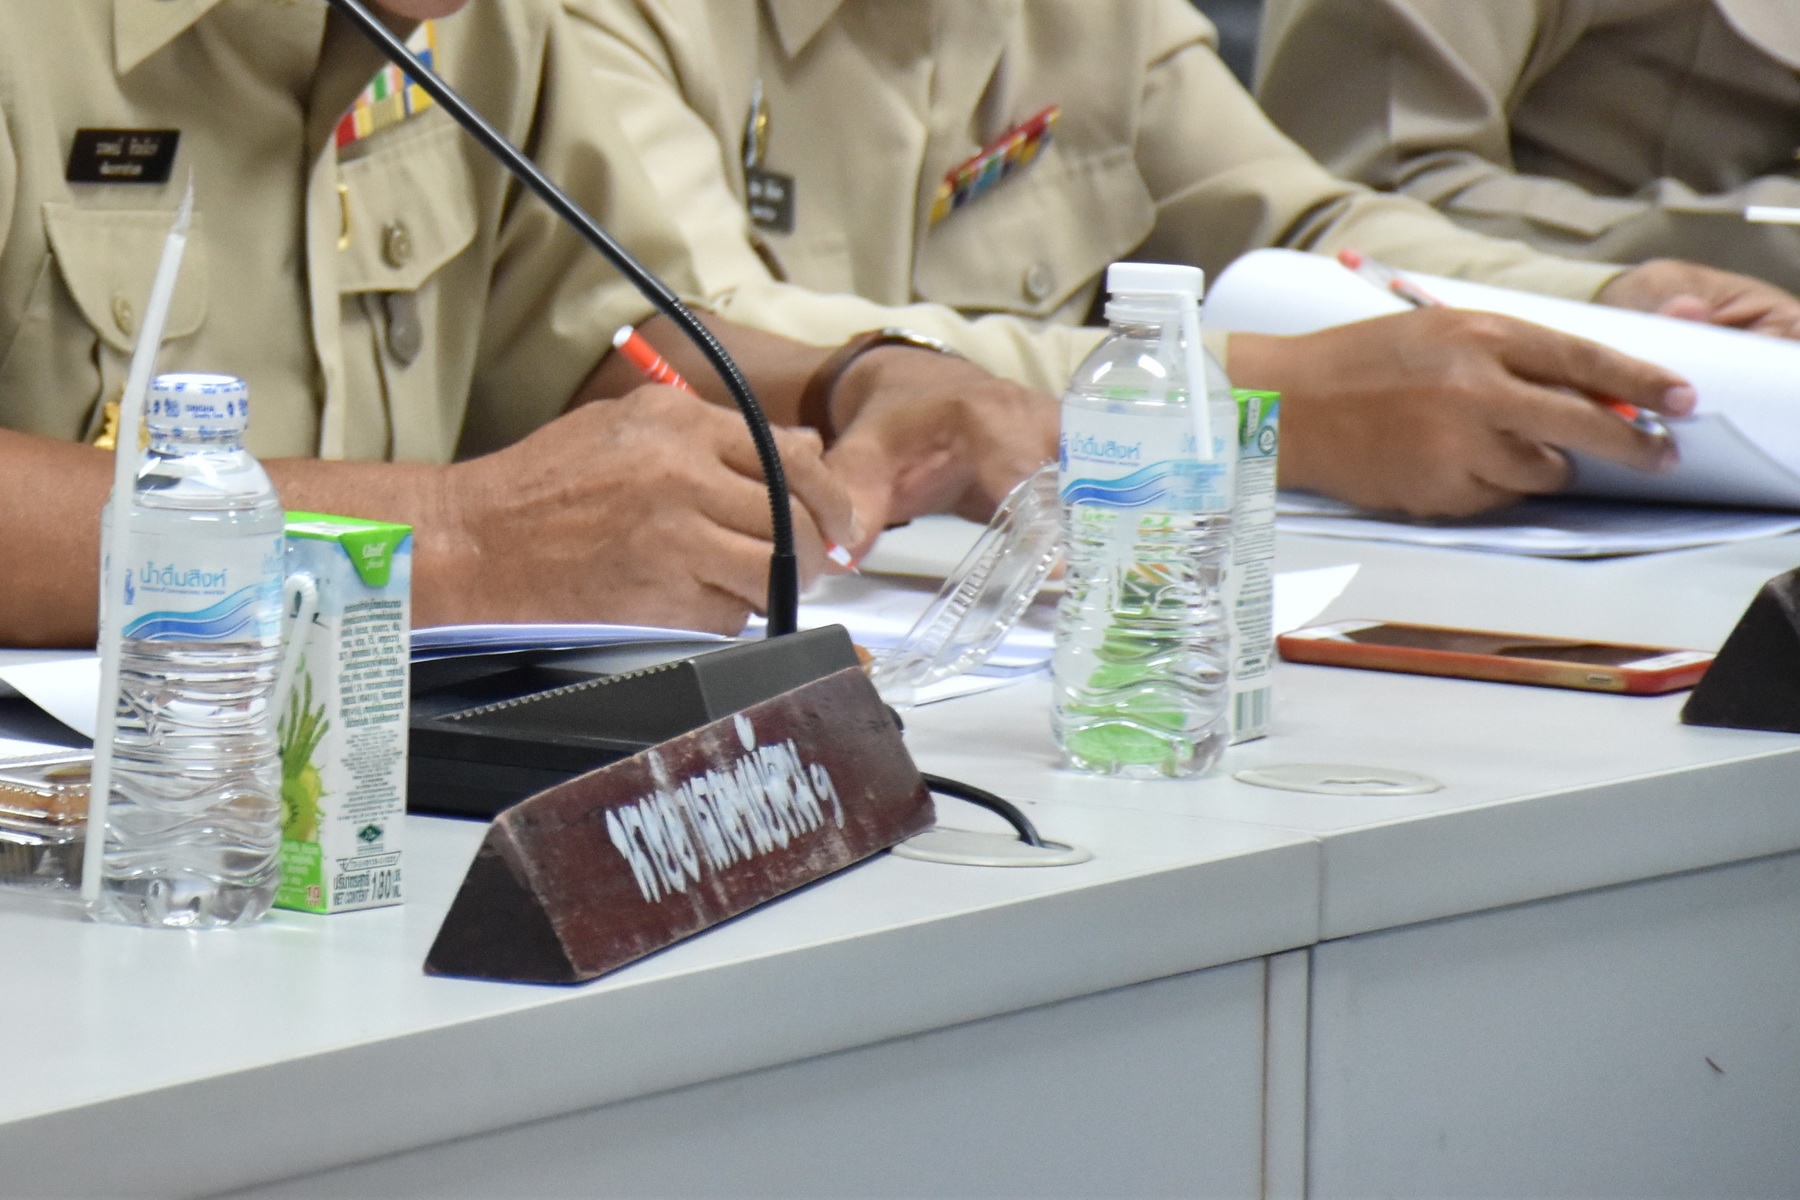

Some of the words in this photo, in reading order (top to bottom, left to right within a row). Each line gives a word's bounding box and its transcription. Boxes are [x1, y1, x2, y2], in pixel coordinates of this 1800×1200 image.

[139, 560, 228, 588] น้ำดื่มสิงห์
